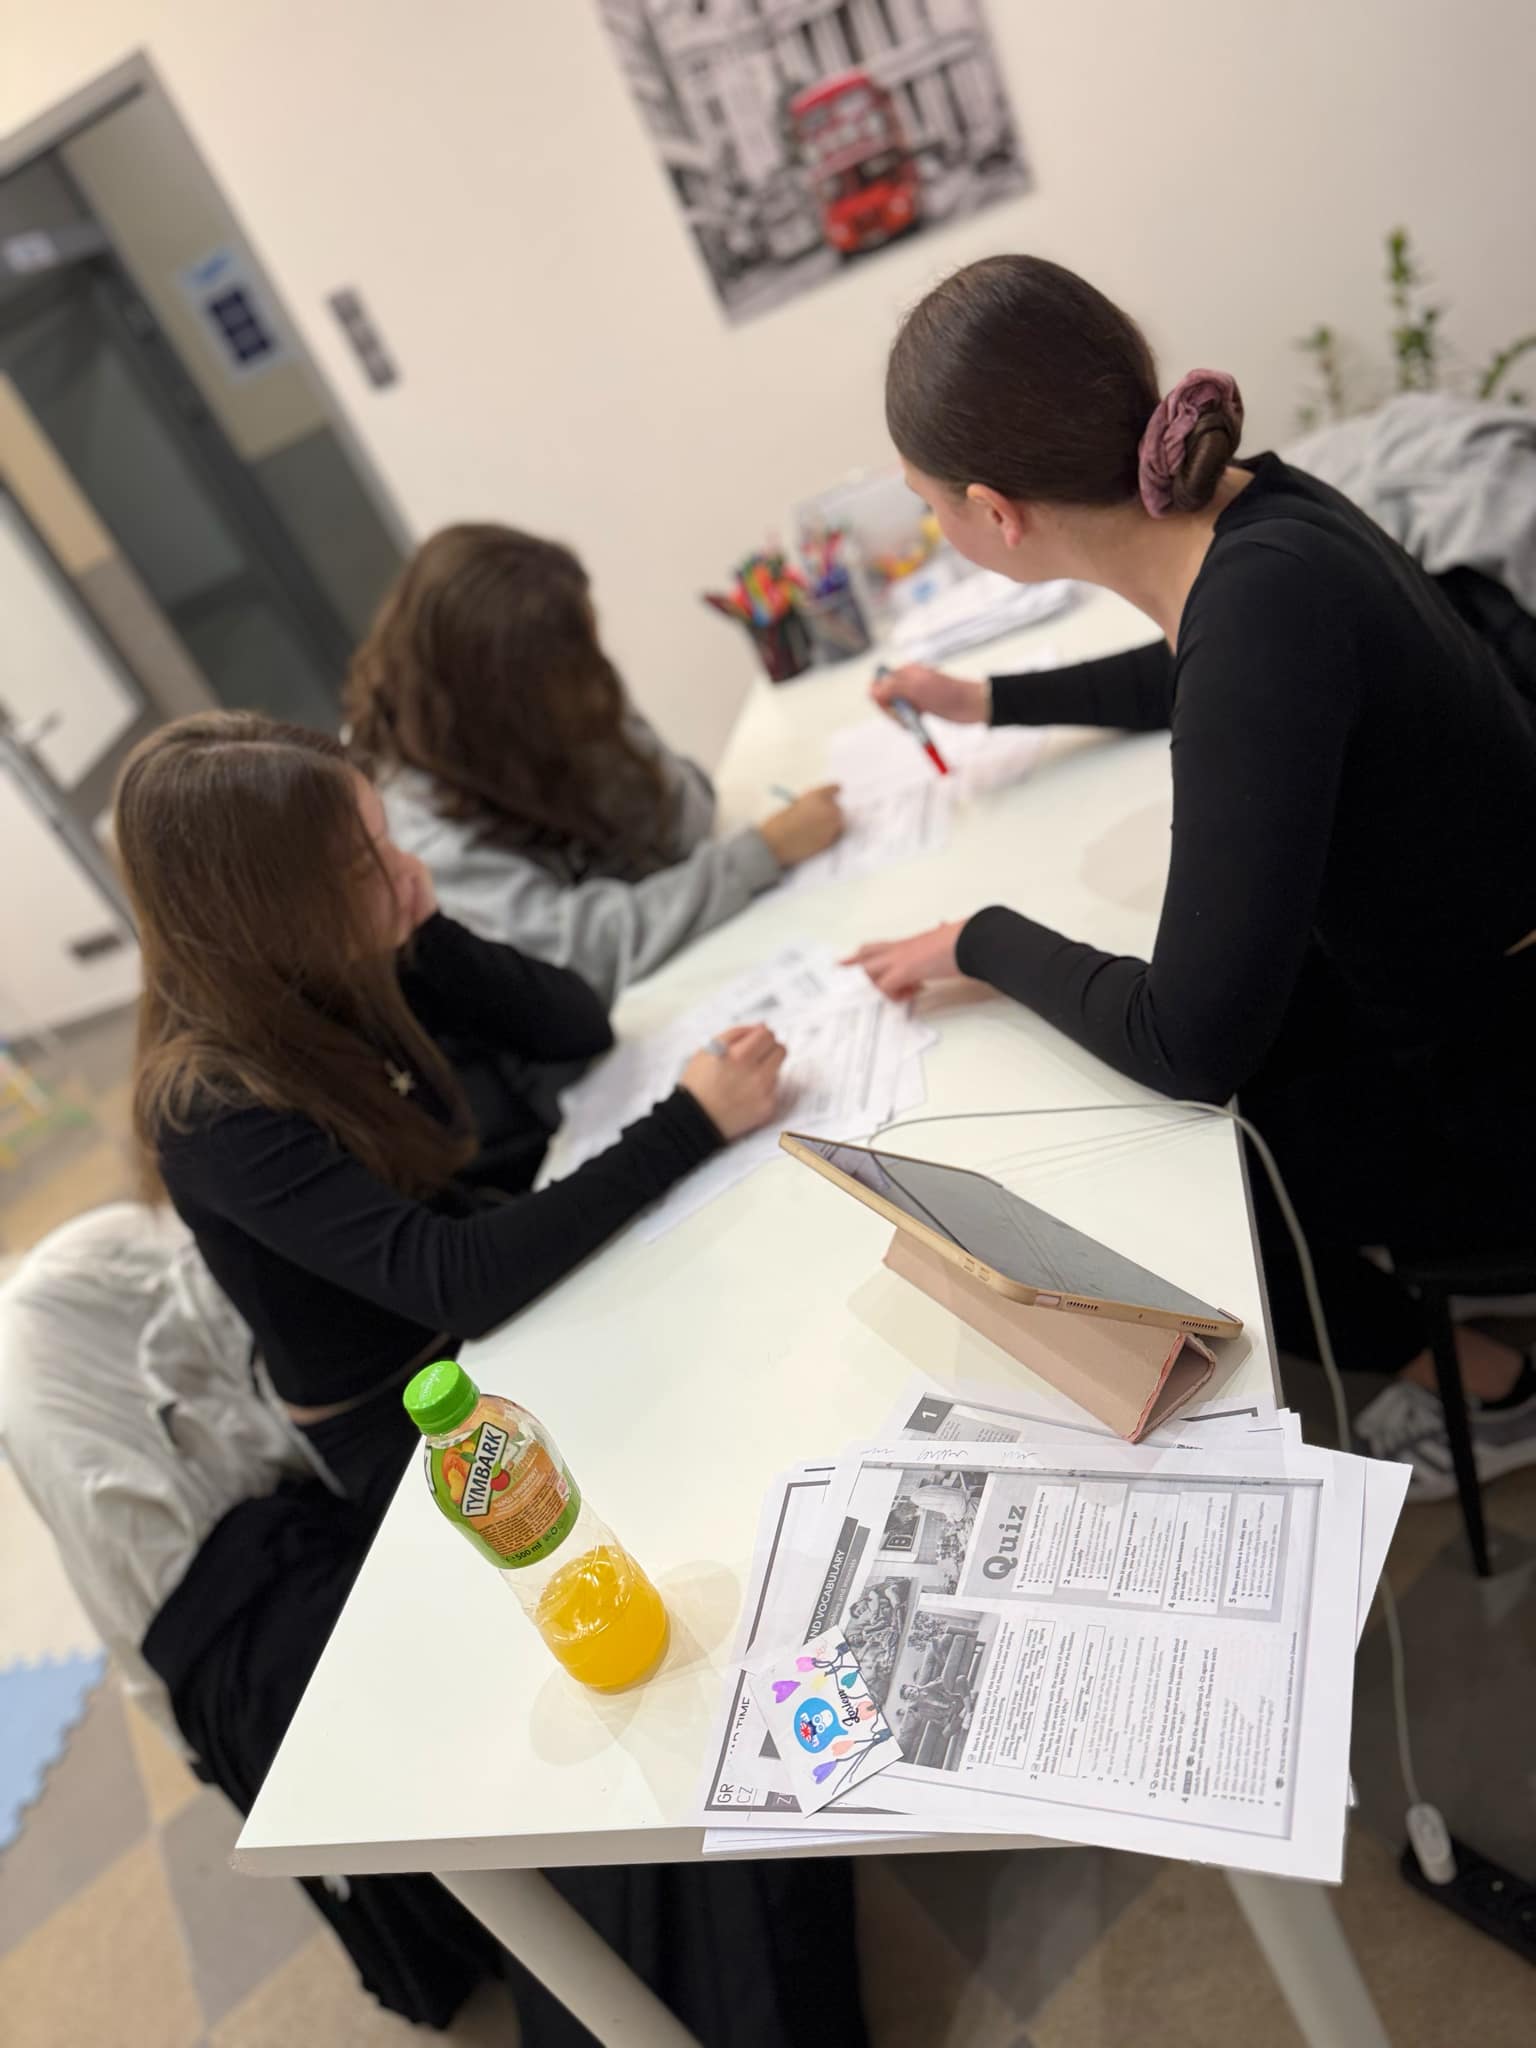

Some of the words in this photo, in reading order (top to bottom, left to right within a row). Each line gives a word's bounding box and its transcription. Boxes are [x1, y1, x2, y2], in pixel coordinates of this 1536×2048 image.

[922, 1410, 937, 1420] 1
[466, 1429, 503, 1513] TYMBARK
[515, 1548, 532, 1561] 500
[531, 1541, 543, 1553] ml
[982, 1505, 1028, 1581] Quiz
[816, 1549, 845, 1616] VOCABULARY
